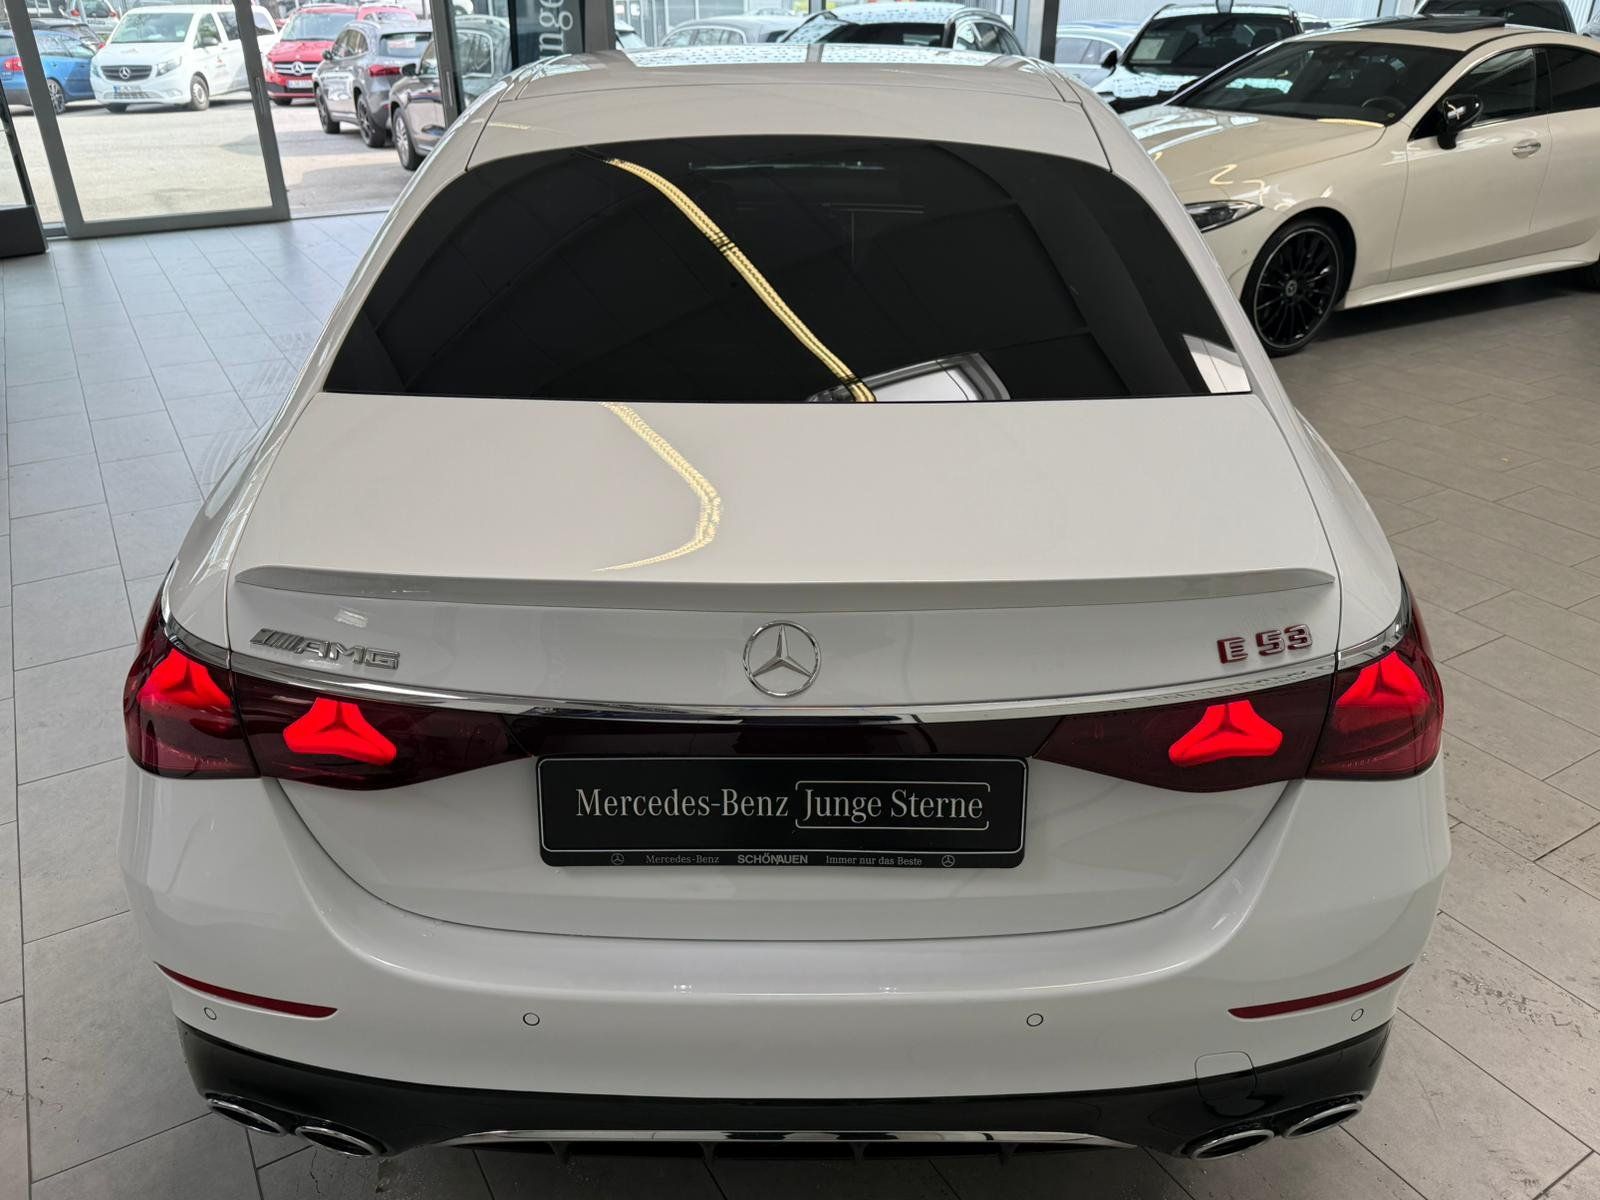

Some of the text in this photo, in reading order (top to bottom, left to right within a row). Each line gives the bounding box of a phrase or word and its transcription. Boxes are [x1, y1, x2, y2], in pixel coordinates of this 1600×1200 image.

[296, 636, 400, 670] AMG
[1217, 623, 1313, 664] E 53
[576, 788, 983, 824] Mercedes-Benz Junge Sterne
[645, 852, 922, 866] Mercedes-Benz SCHÖNAUEN Immer nur das Beste
